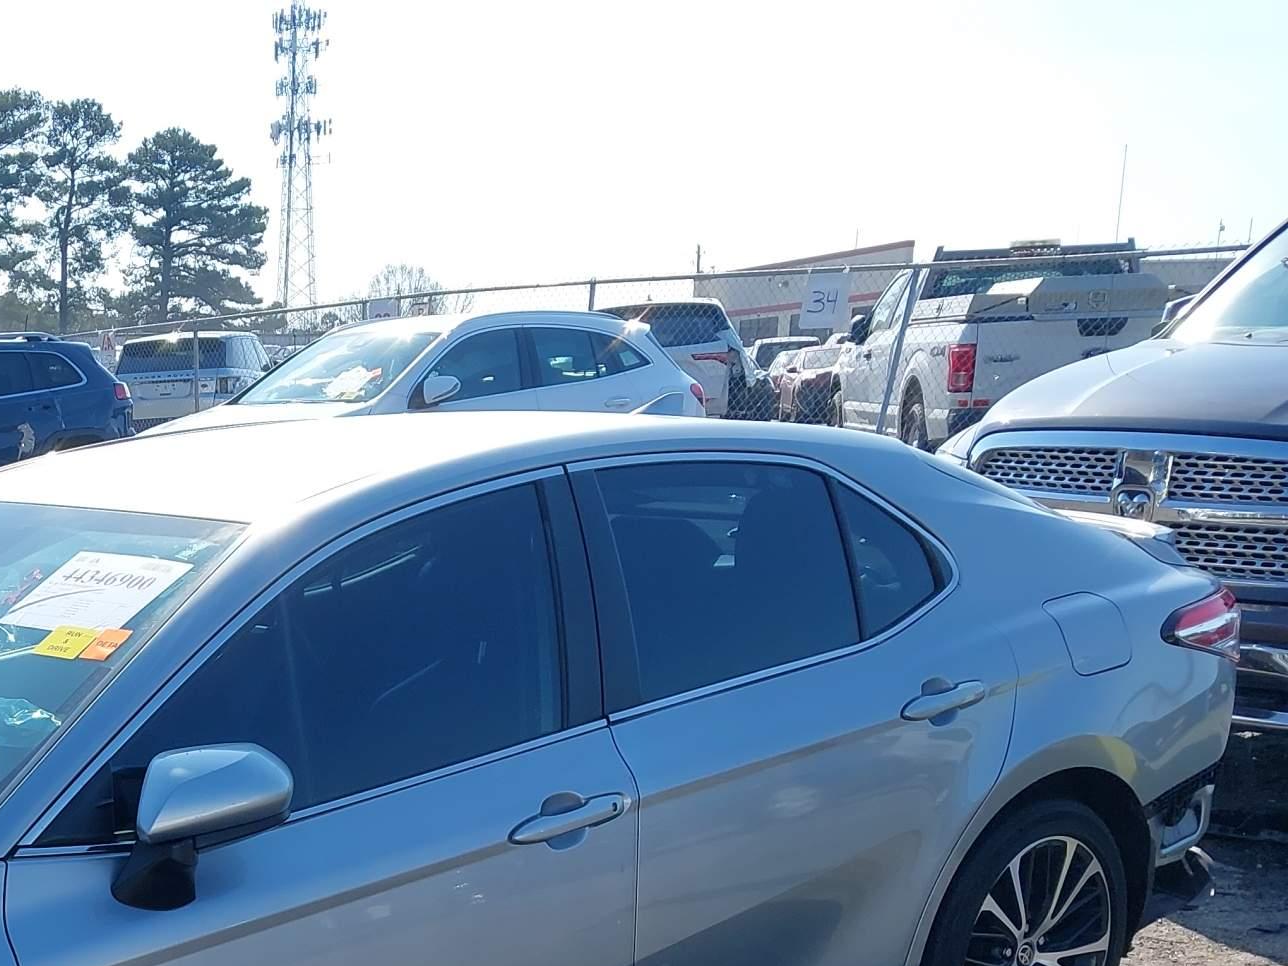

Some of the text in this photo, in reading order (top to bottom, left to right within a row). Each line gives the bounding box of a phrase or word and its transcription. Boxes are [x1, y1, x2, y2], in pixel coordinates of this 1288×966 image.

[806, 288, 839, 314] 34
[62, 568, 157, 590] 44346900
[66, 630, 83, 638] RUN
[47, 645, 70, 653] DRIVE
